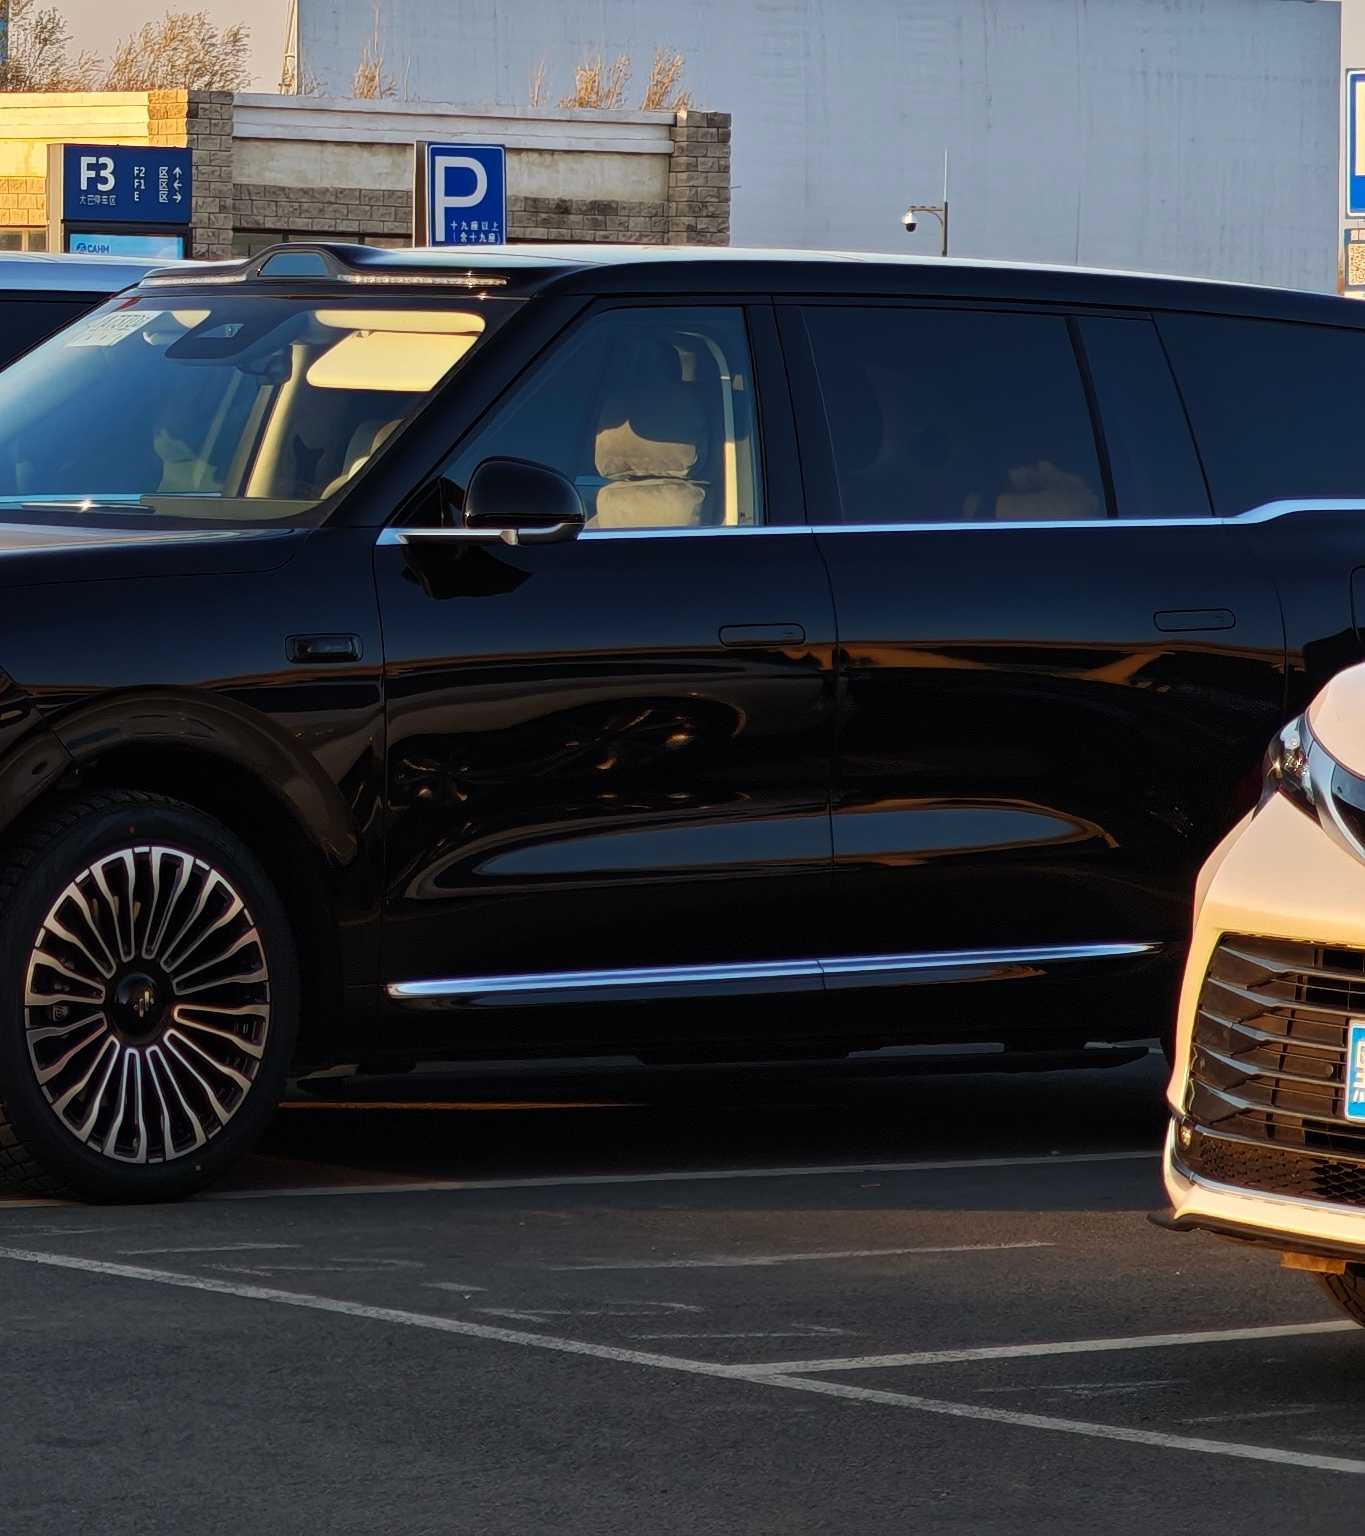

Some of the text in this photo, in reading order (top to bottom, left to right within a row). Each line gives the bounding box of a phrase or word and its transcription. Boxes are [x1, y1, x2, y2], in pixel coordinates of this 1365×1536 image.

[80, 156, 116, 192] F3
[133, 166, 169, 179] F2 区
[133, 178, 169, 191] F1 区
[133, 191, 169, 203] E 区
[434, 155, 488, 242] P
[87, 244, 110, 254] CAHM
